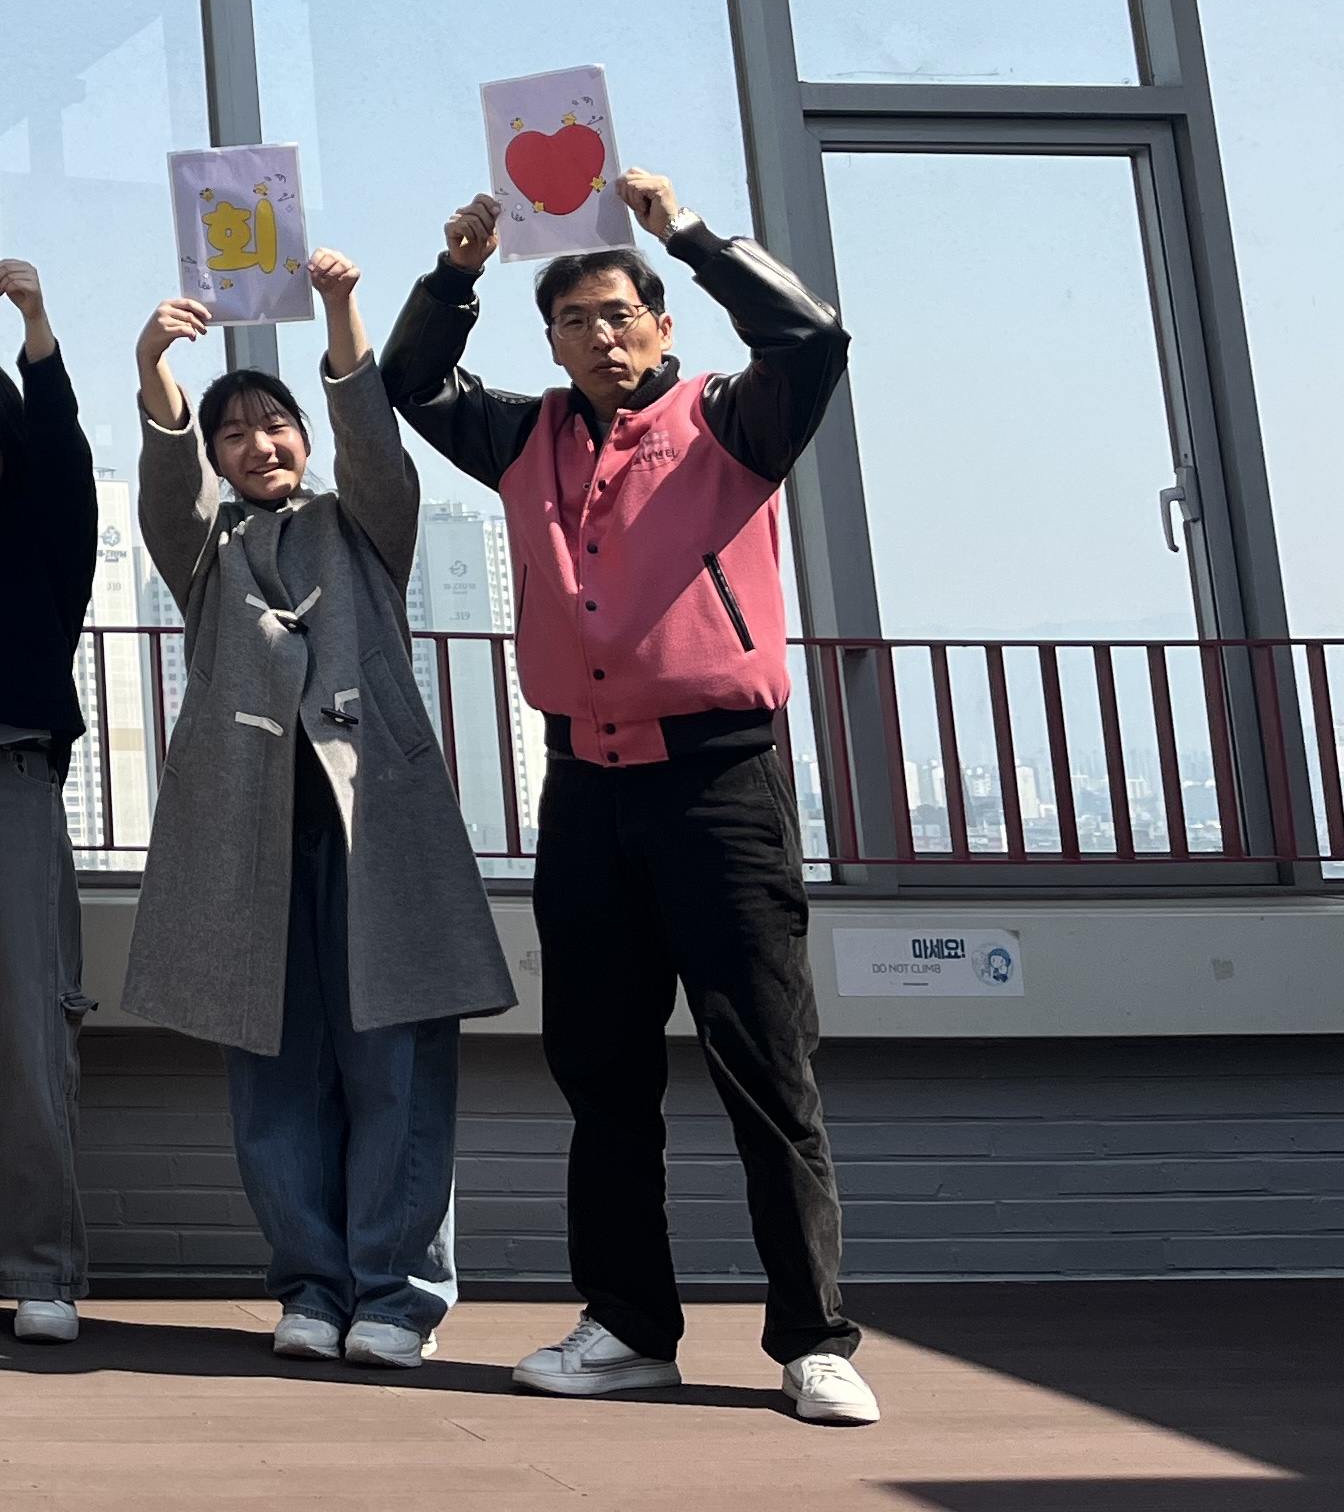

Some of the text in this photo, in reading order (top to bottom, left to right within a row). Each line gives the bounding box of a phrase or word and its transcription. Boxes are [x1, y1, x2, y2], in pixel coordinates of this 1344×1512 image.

[201, 198, 277, 274] 회
[912, 938, 966, 959] 마세요!
[872, 964, 941, 974] DO NOT CLIMB
